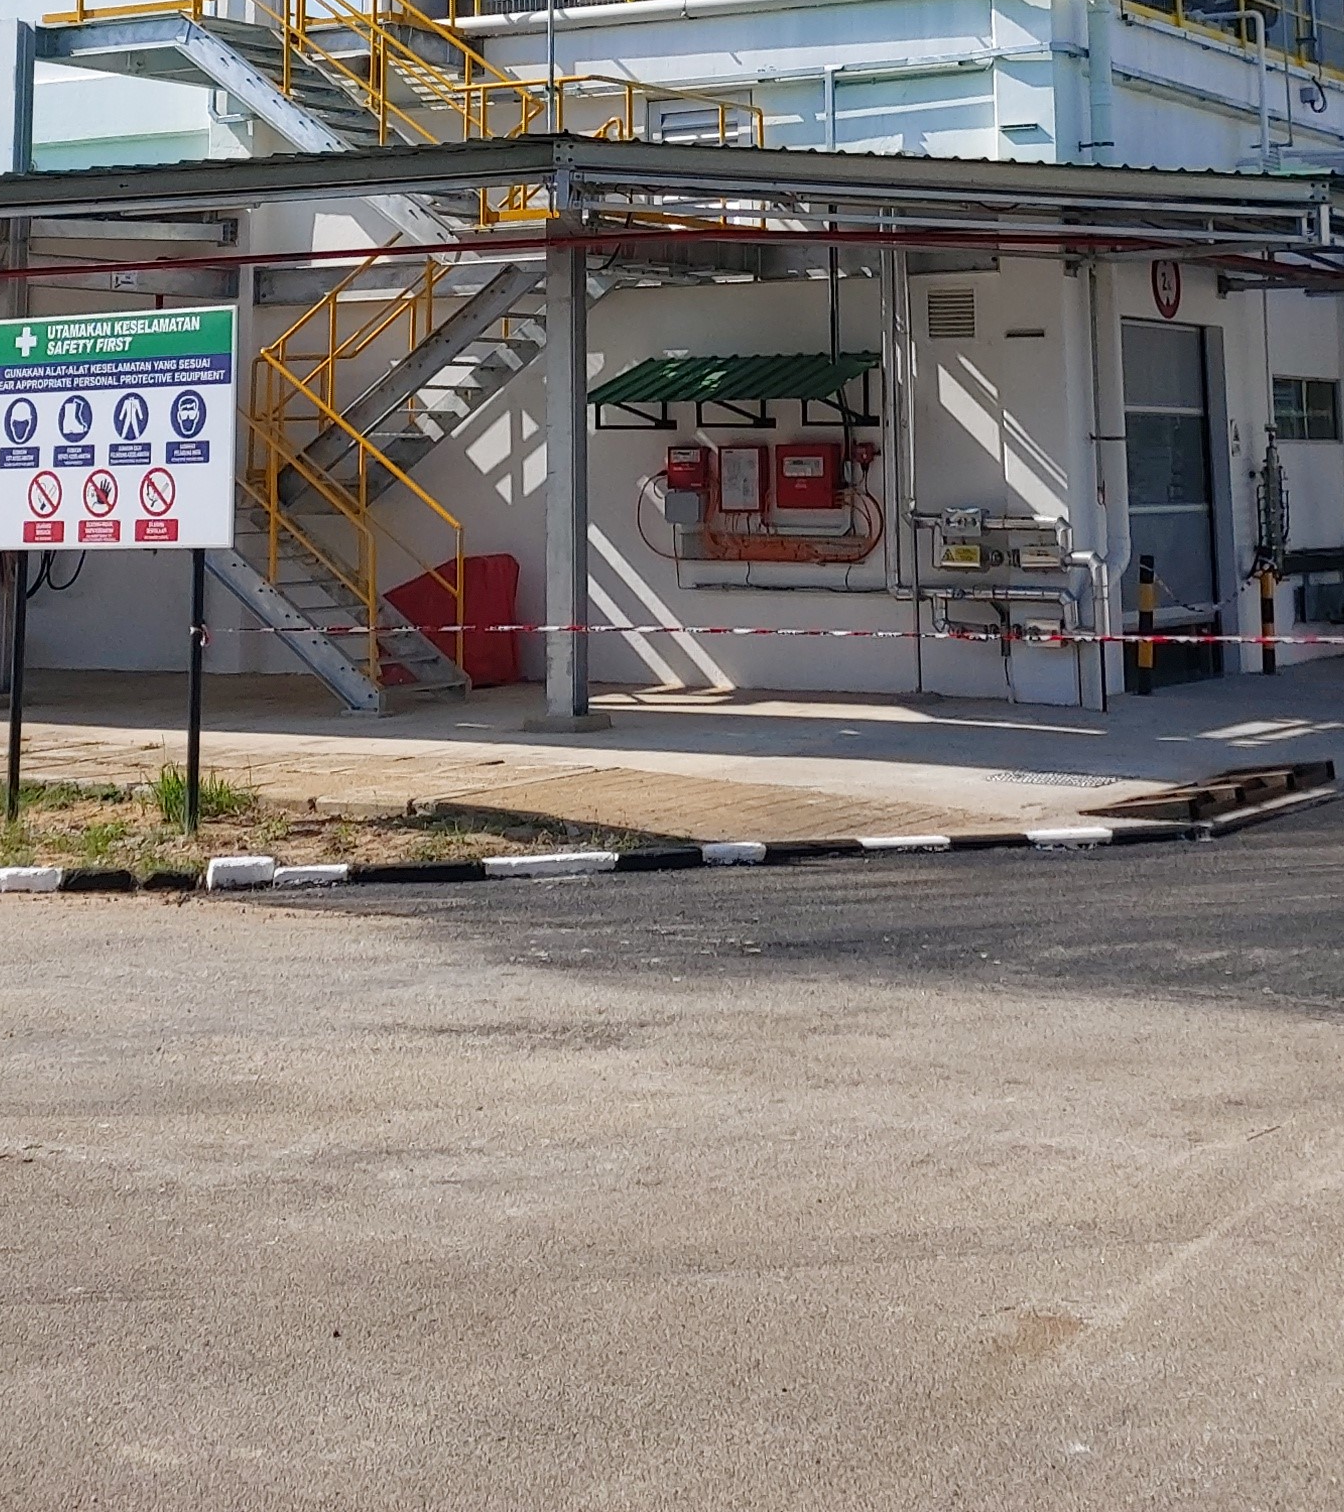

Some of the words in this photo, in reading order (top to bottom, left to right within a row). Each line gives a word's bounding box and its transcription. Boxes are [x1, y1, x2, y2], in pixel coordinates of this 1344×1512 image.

[47, 321, 112, 340] UTAMAKAN
[113, 316, 200, 336] KESELAMATAN
[47, 338, 95, 356] SAFETY
[95, 336, 133, 353] FIRST
[4, 367, 44, 379] GUNAKAN
[45, 364, 90, 377] ALAT-ALAT
[90, 361, 152, 374] KESELAMATAN
[153, 359, 177, 370] YANG
[178, 357, 211, 369] SESUAI
[16, 377, 72, 390] APPROPRIATE
[73, 375, 121, 387] PERSONAL
[120, 372, 173, 385] PROTECTIVE
[174, 369, 226, 382] EQUIPMENT
